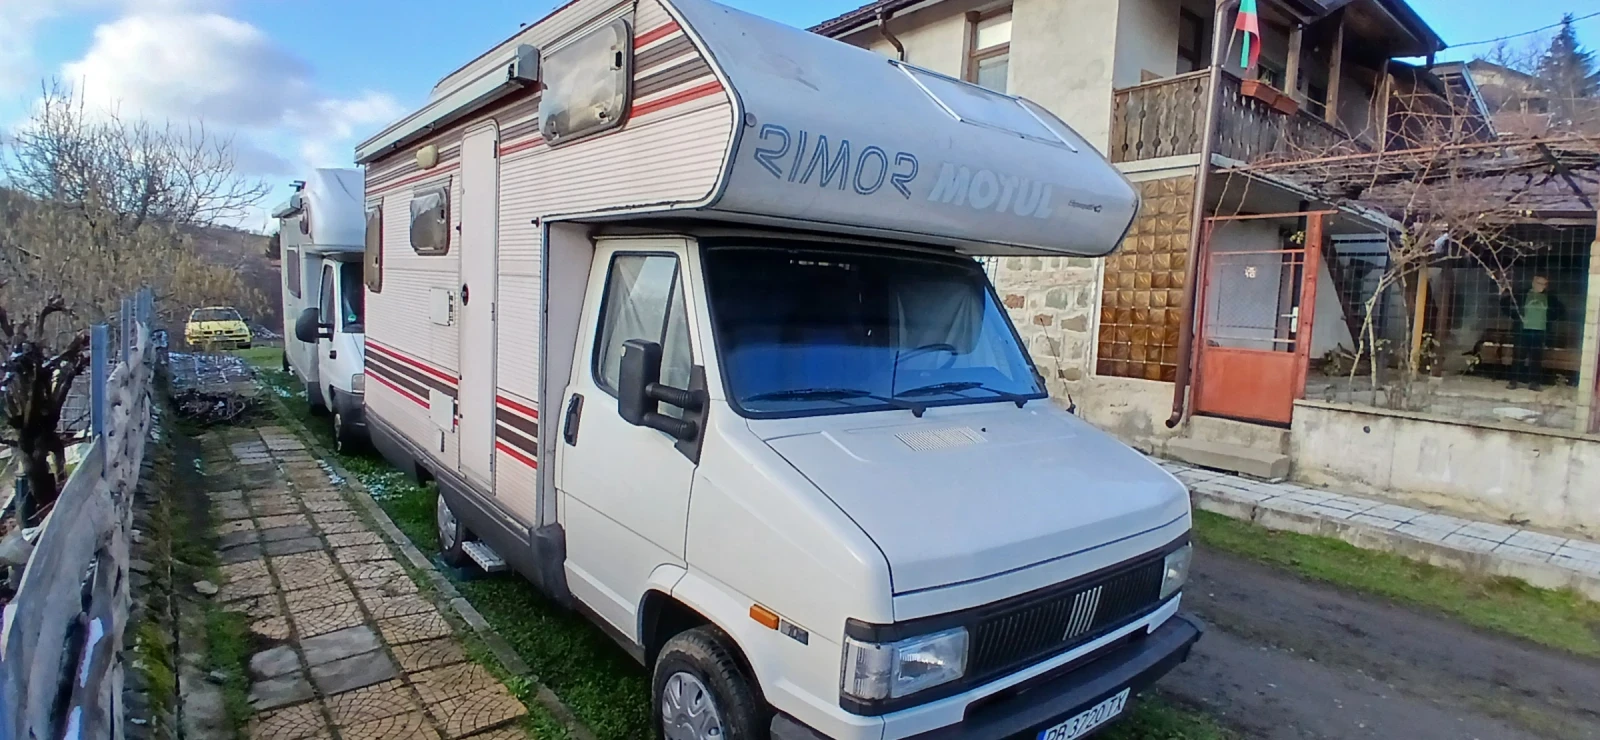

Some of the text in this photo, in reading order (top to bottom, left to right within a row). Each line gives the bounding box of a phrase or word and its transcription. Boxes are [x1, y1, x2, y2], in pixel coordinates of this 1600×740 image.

[753, 123, 1056, 220] RIMOR MOTUL
[1067, 704, 1105, 738] 3720
[1106, 692, 1126, 716] TX
